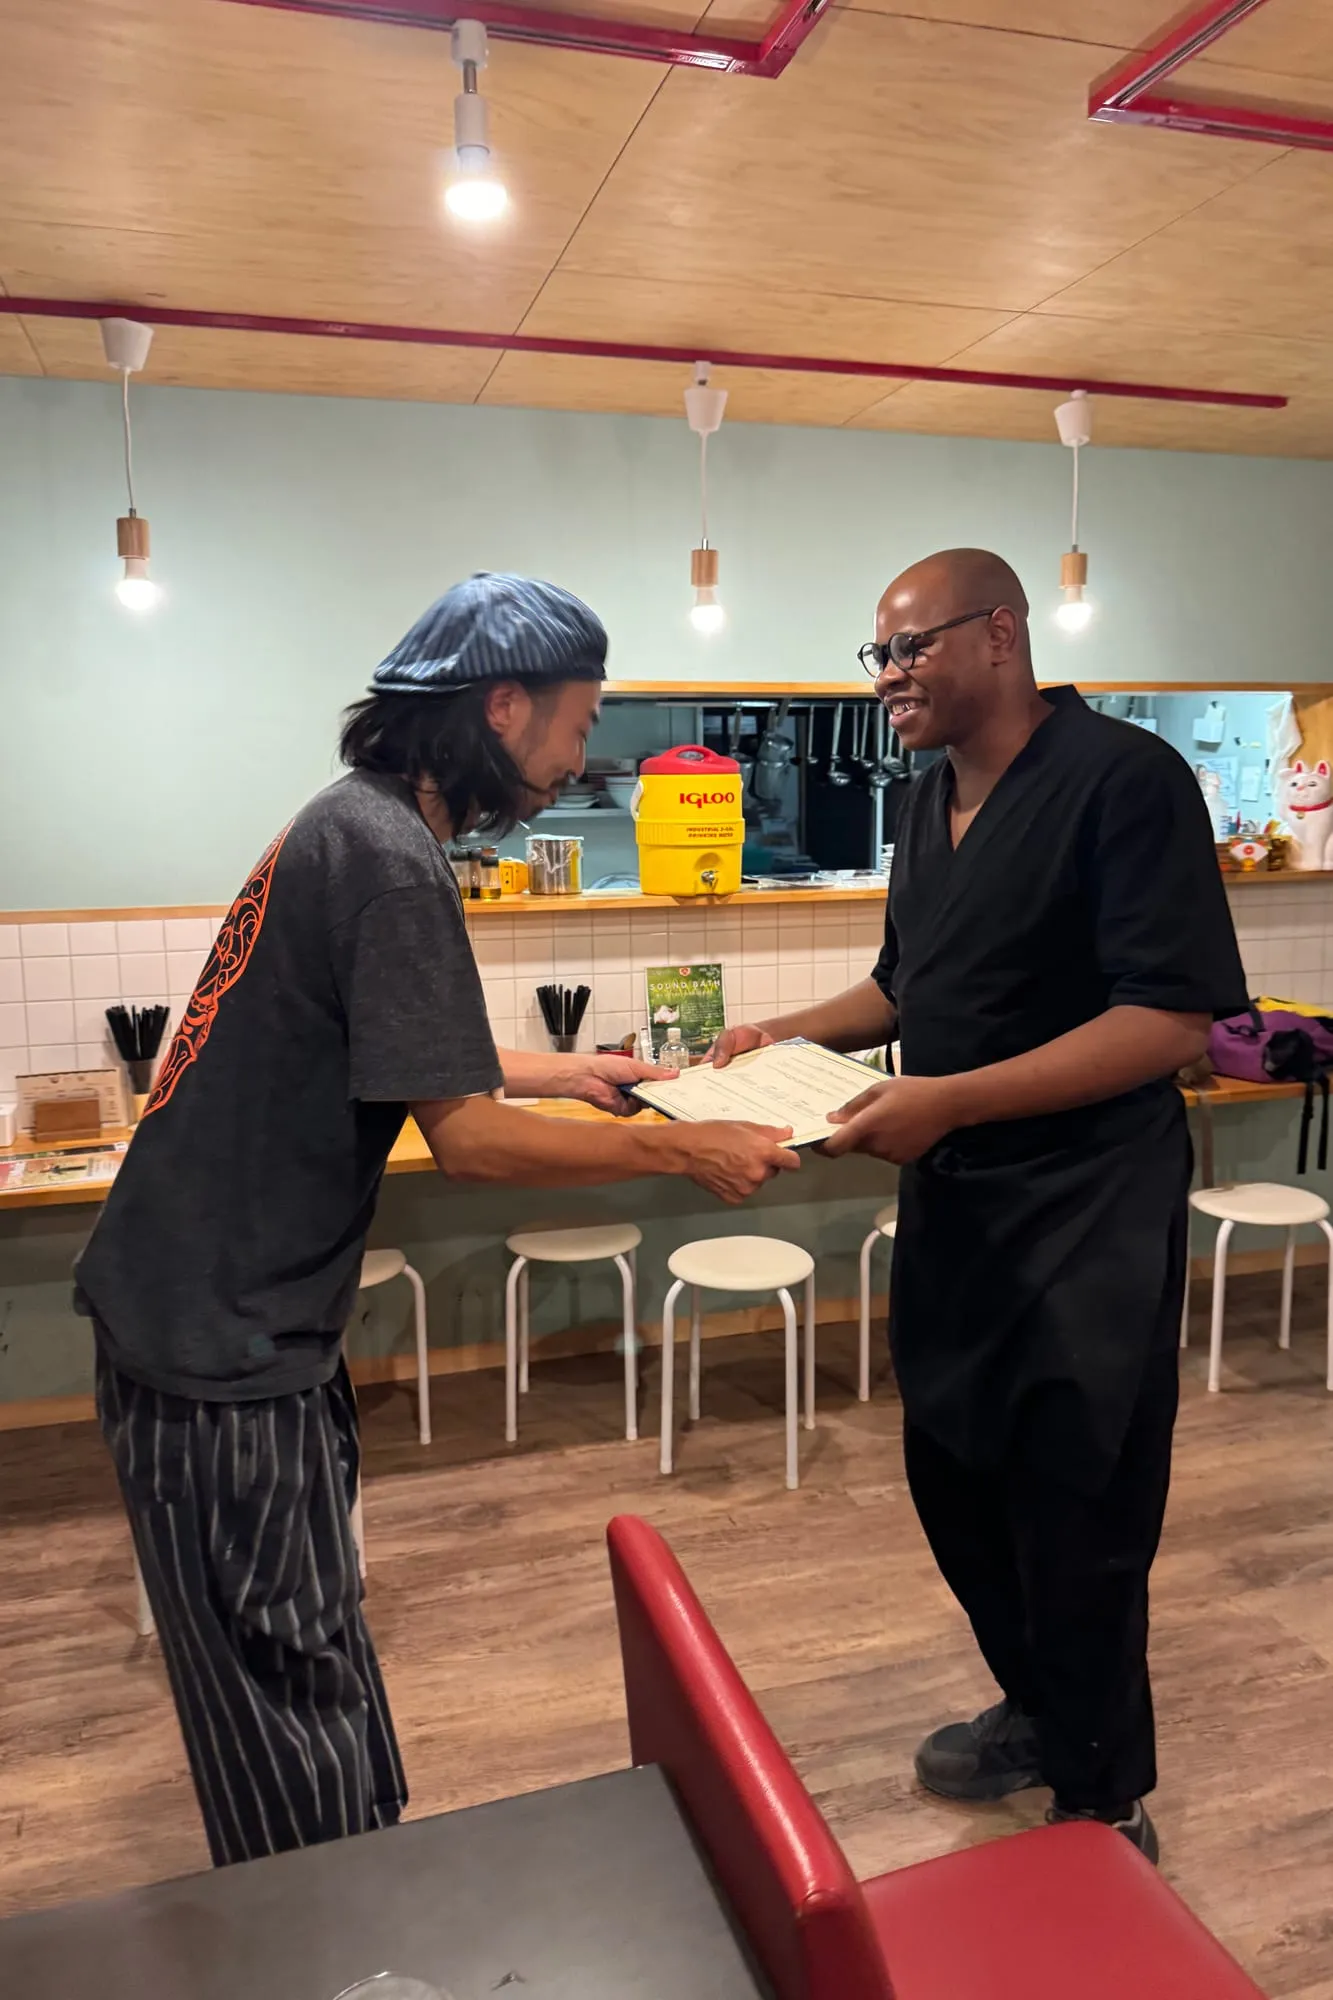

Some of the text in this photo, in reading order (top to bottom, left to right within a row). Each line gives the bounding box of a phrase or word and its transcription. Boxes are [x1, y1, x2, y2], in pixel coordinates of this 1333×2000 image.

[679, 792, 735, 809] IGLOO
[649, 980, 721, 990] SOUND BATH
